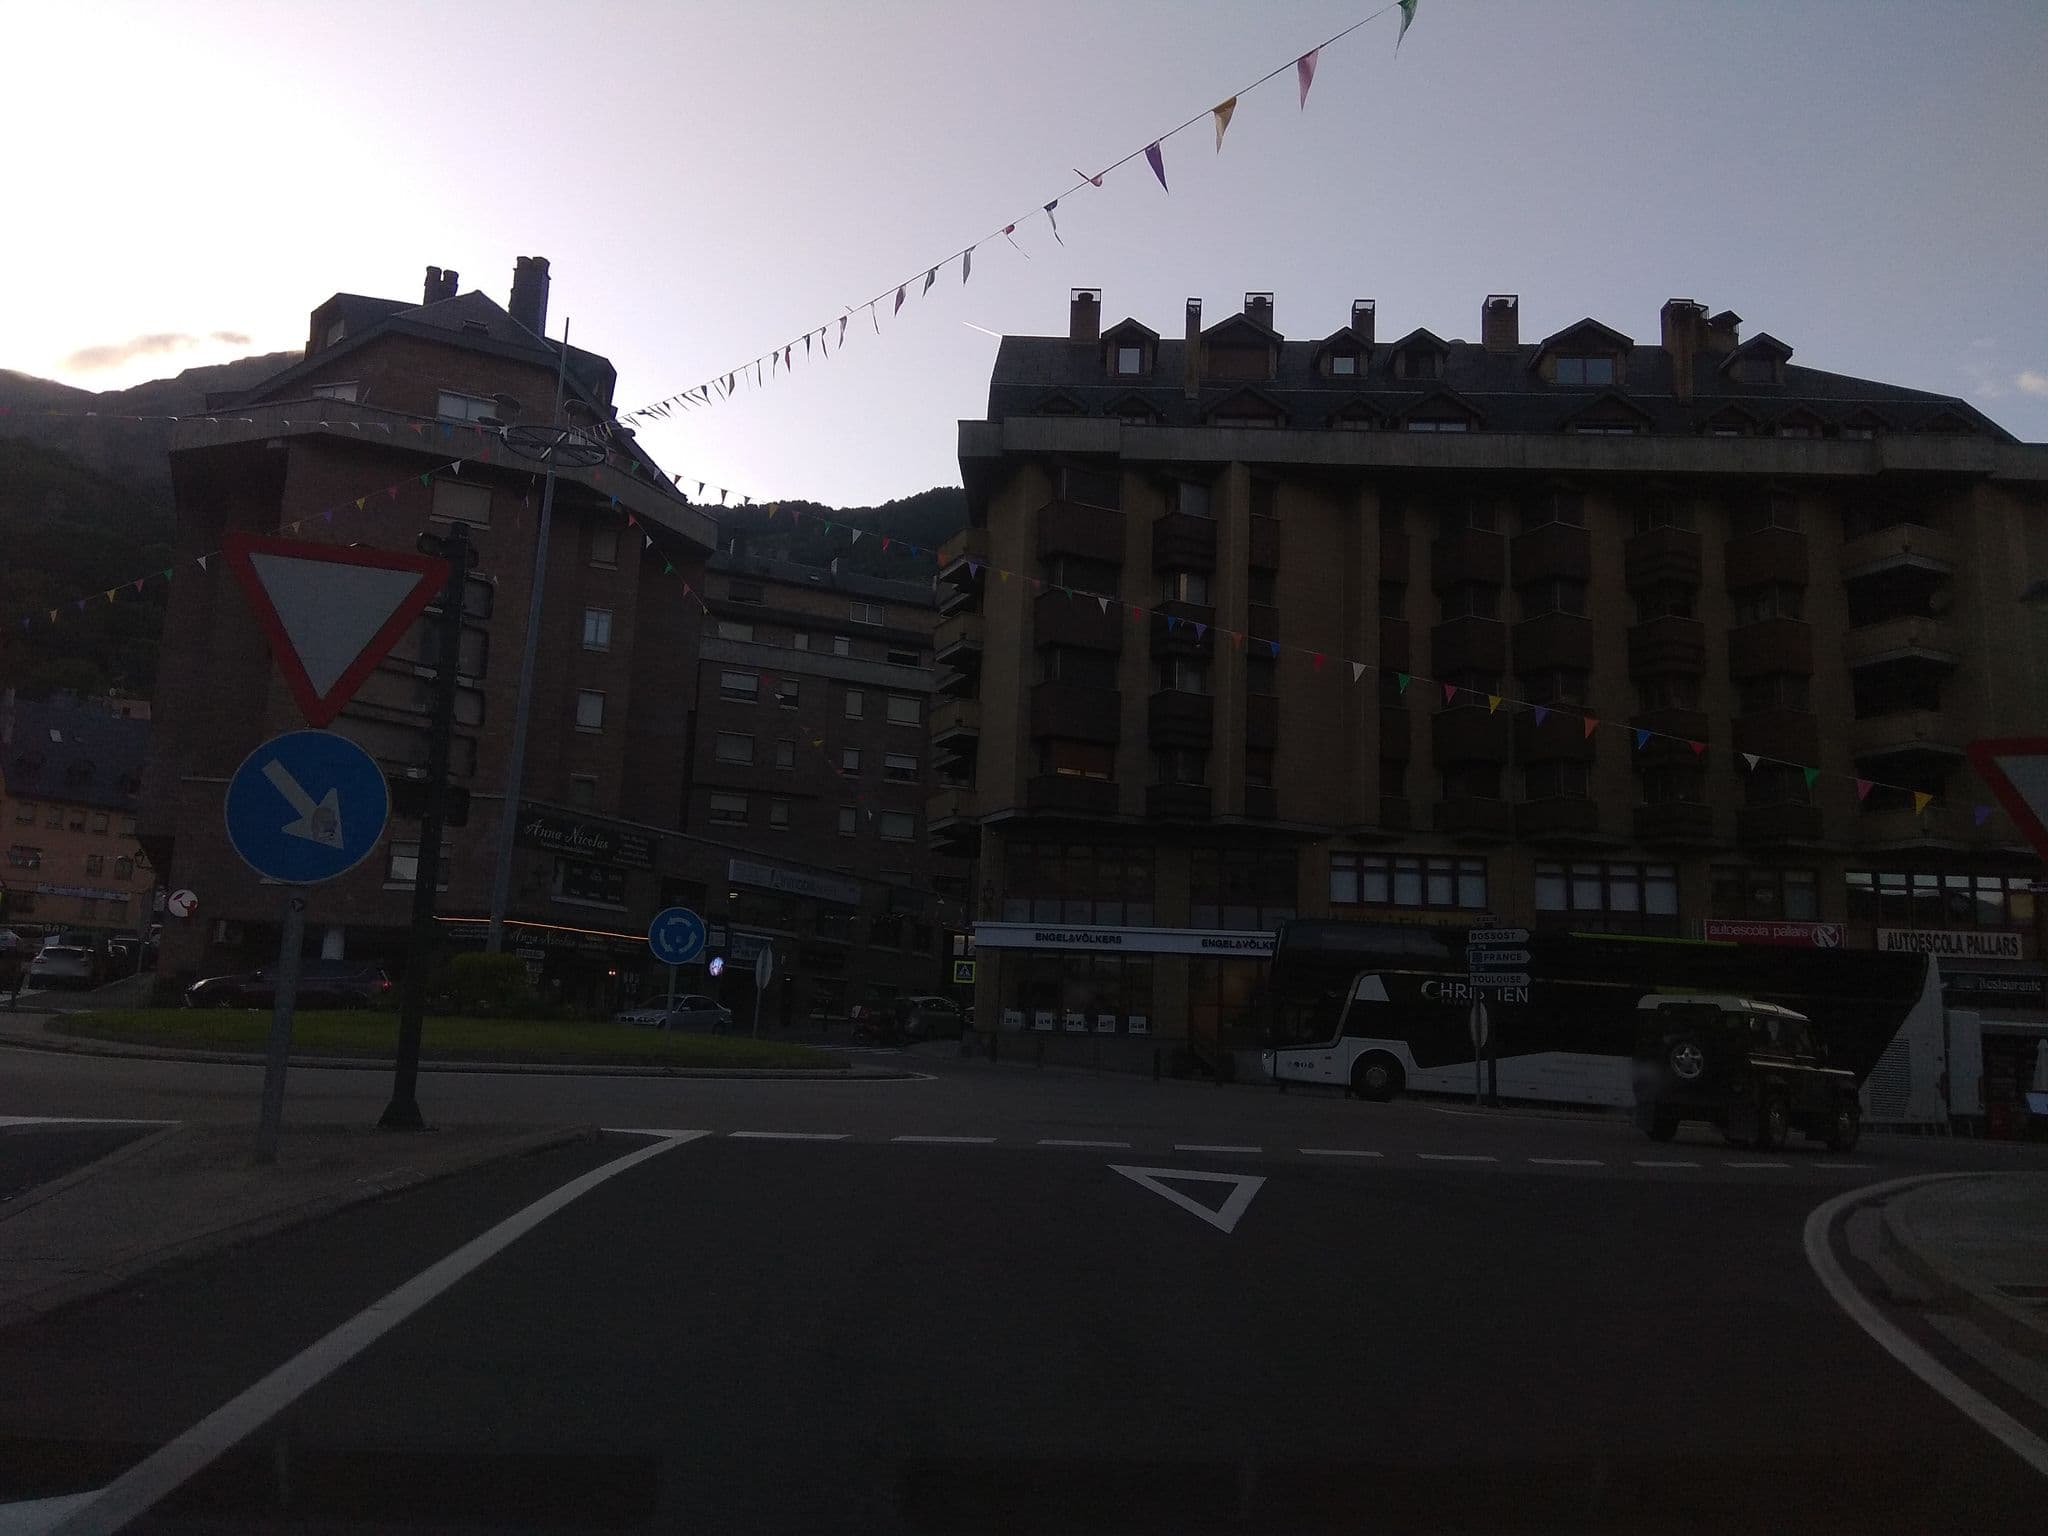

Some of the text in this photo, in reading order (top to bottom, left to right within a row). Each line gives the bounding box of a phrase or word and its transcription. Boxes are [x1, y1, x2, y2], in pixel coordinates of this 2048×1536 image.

[1471, 932, 1516, 941] BOSSOST
[1709, 924, 1809, 939] autoescola pallars
[1887, 932, 2018, 956] AUTOESCOLA PALLARS
[1483, 952, 1522, 962] FRANCE
[1472, 975, 1522, 985] TOULOUSE
[1420, 980, 1529, 1004] CHRIIEN
